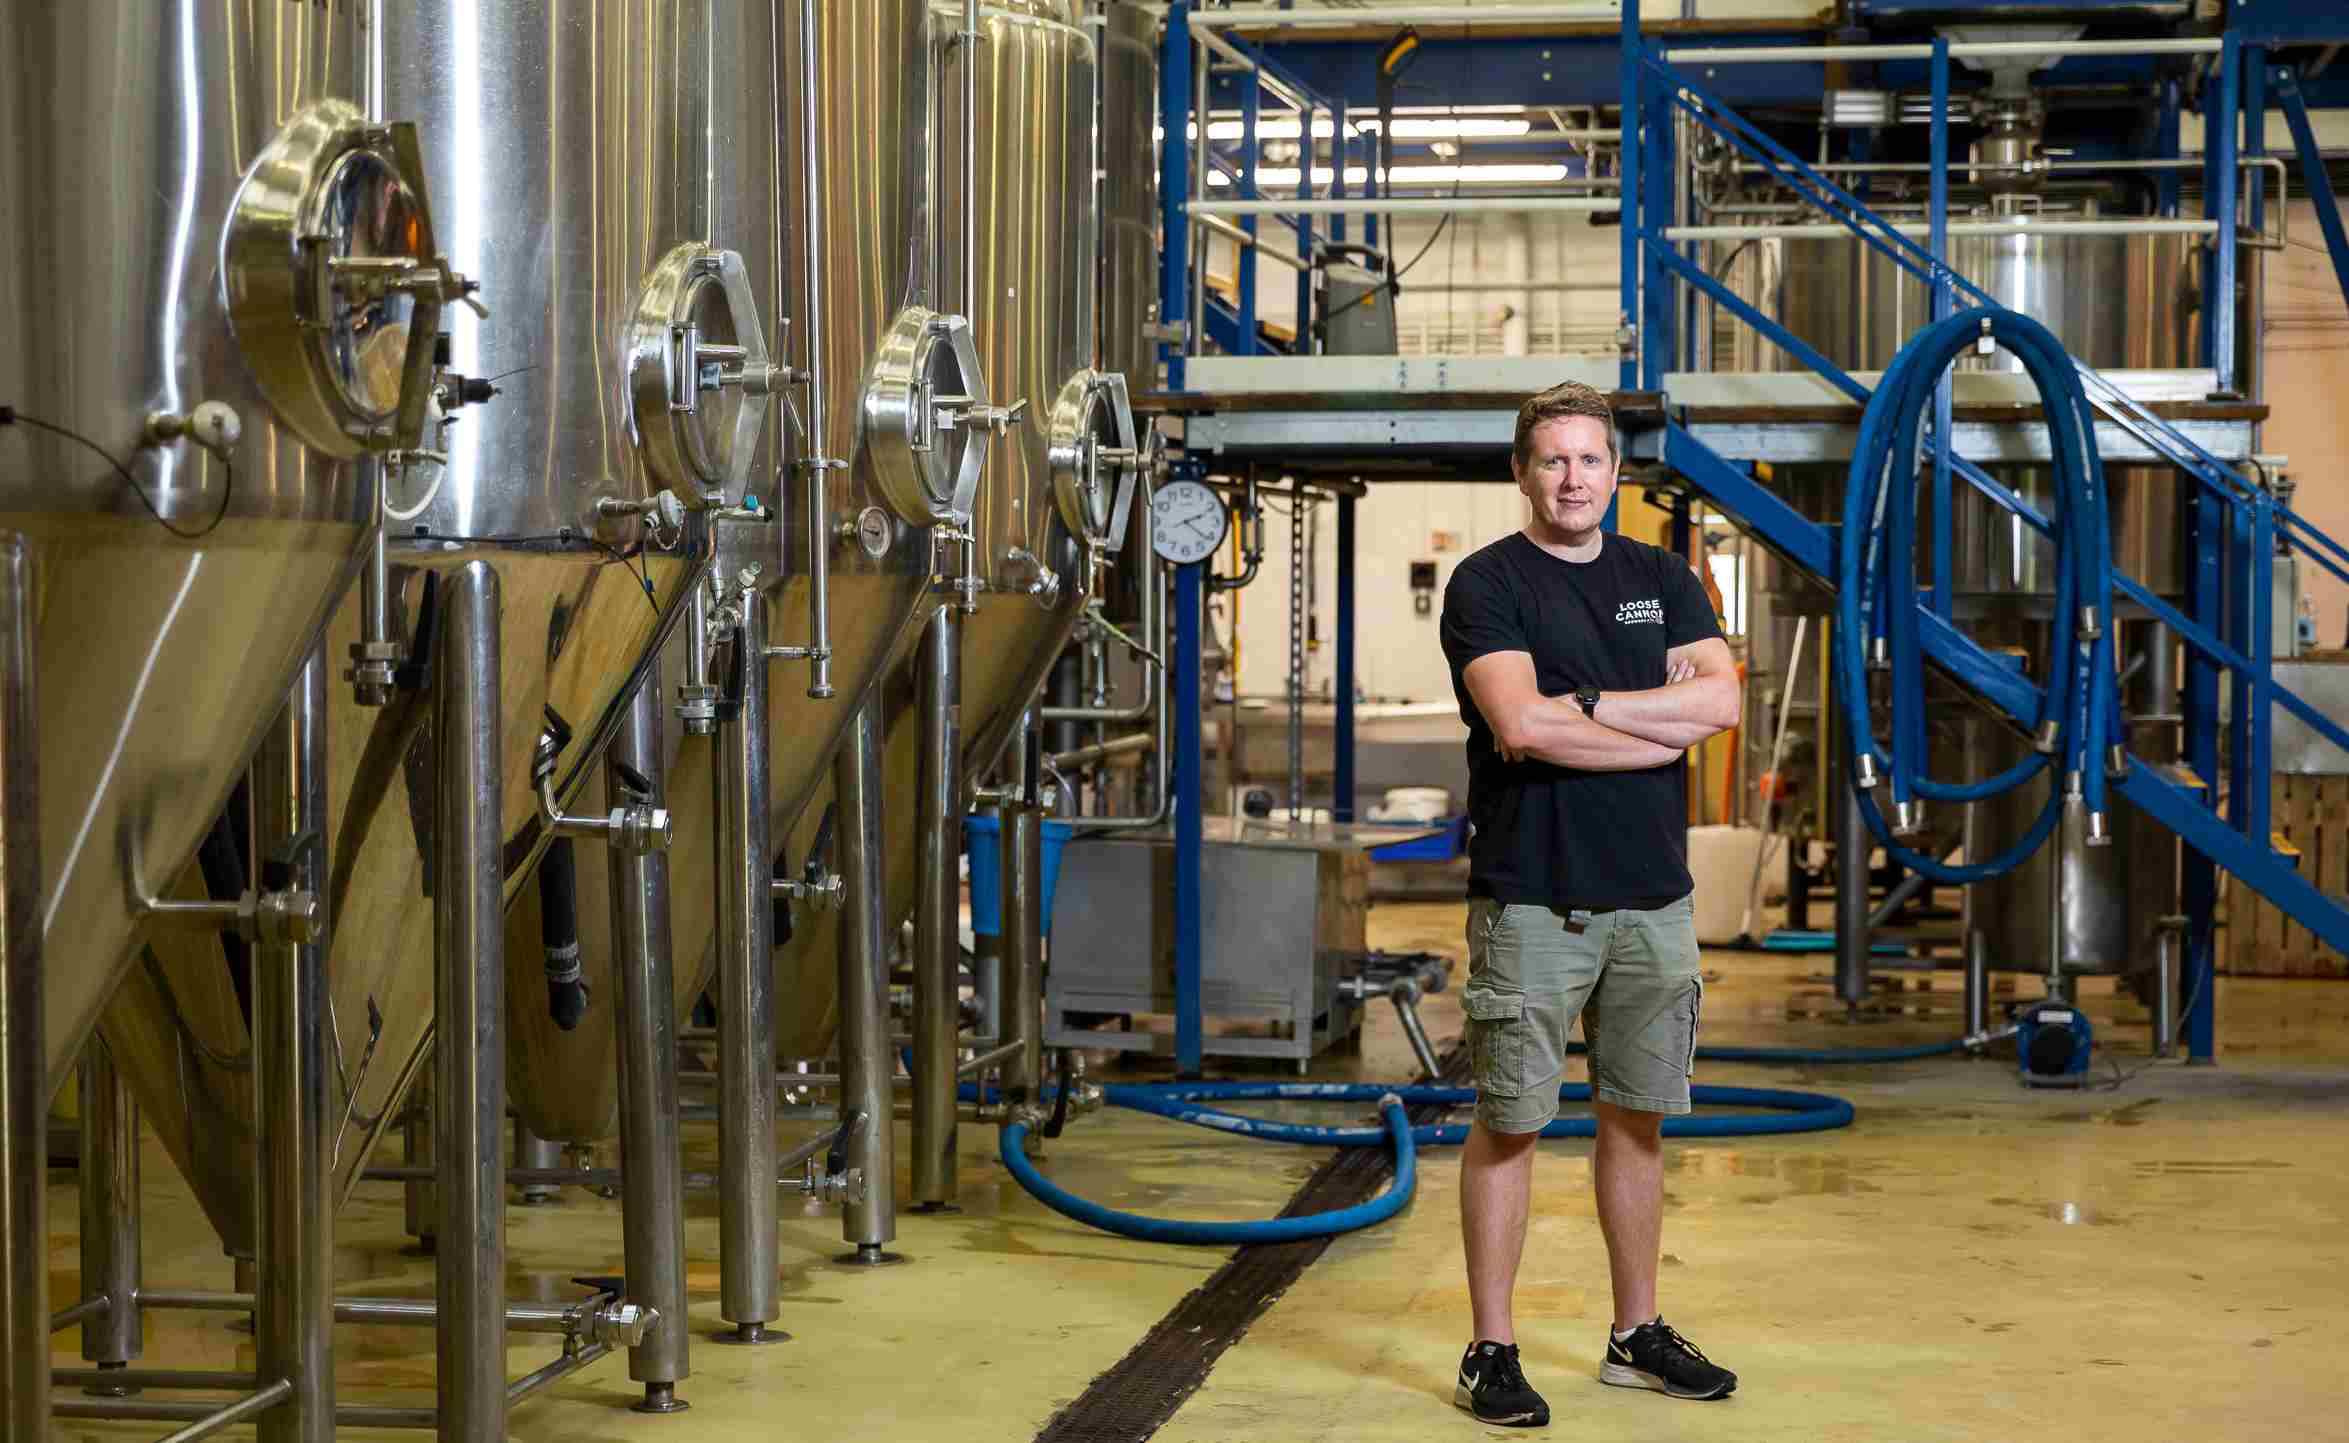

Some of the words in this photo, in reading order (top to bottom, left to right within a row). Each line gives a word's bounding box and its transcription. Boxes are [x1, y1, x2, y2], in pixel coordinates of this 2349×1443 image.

[1180, 487, 1192, 499] 12
[1157, 502, 1170, 513] 10
[1206, 502, 1215, 513] 2
[1157, 531, 1166, 543] 8
[1169, 541, 1177, 552] 7
[1181, 545, 1191, 557] 6
[1619, 599, 1661, 612] LOOSE
